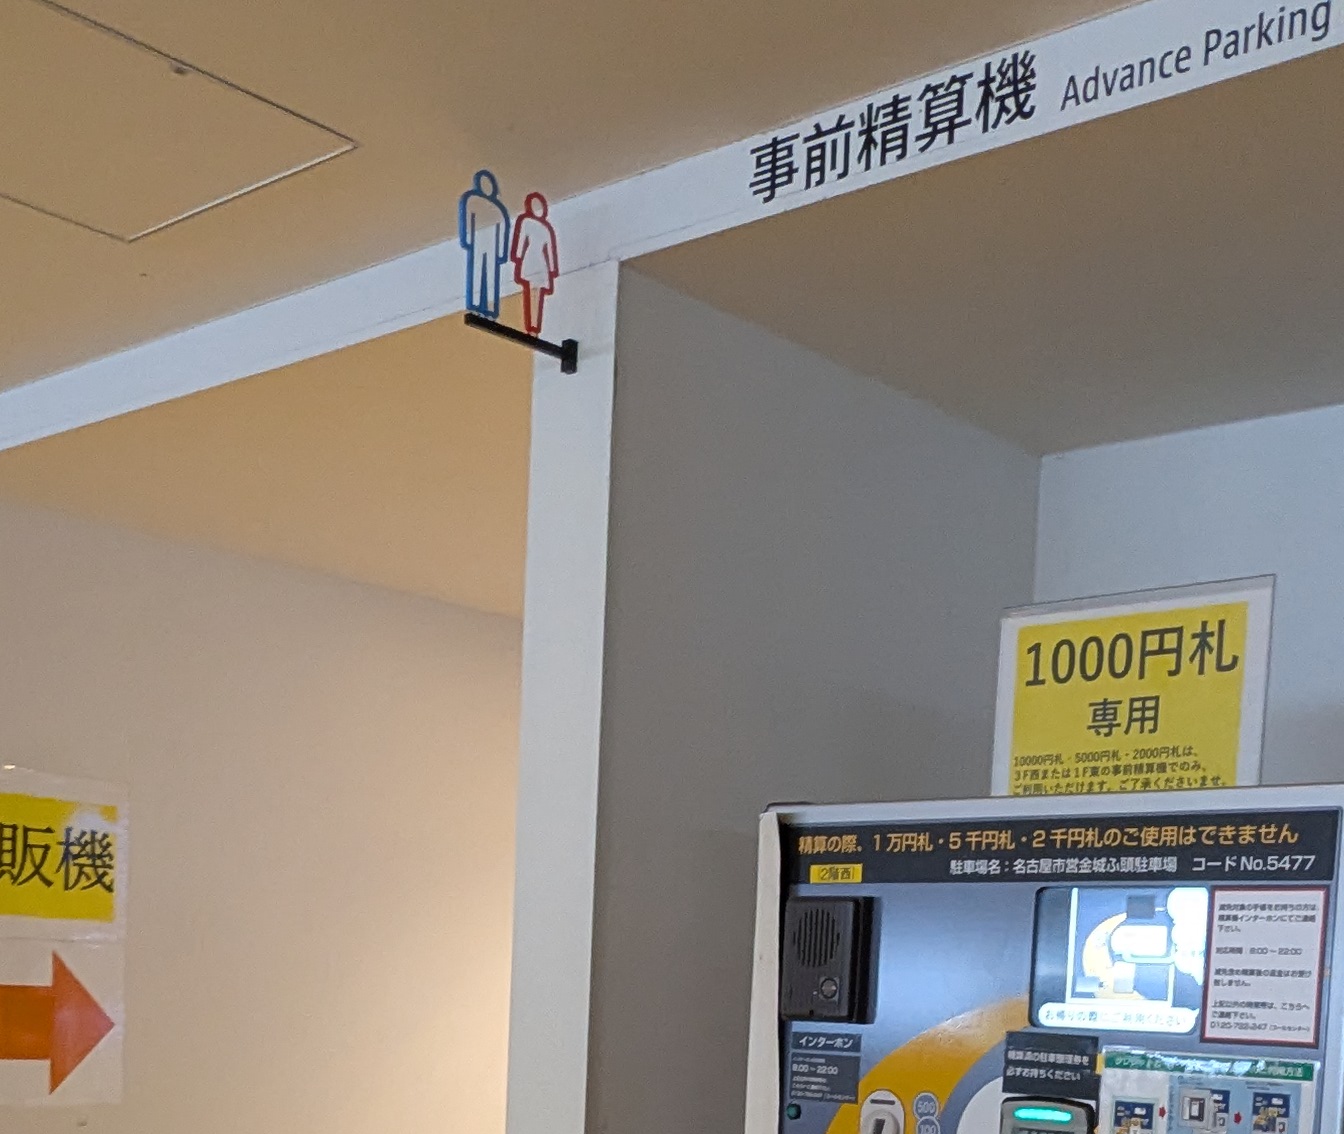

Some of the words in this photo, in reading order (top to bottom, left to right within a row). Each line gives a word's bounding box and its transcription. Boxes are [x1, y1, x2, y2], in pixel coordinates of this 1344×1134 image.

[1060, 40, 1191, 111] Advance
[1203, 1, 1331, 66] Parking
[748, 49, 1037, 204] 事前精算機
[1025, 619, 1239, 686] 1000円札
[1087, 695, 1160, 737] 専用
[799, 1036, 853, 1048] インターホン
[917, 1100, 935, 1113] 500
